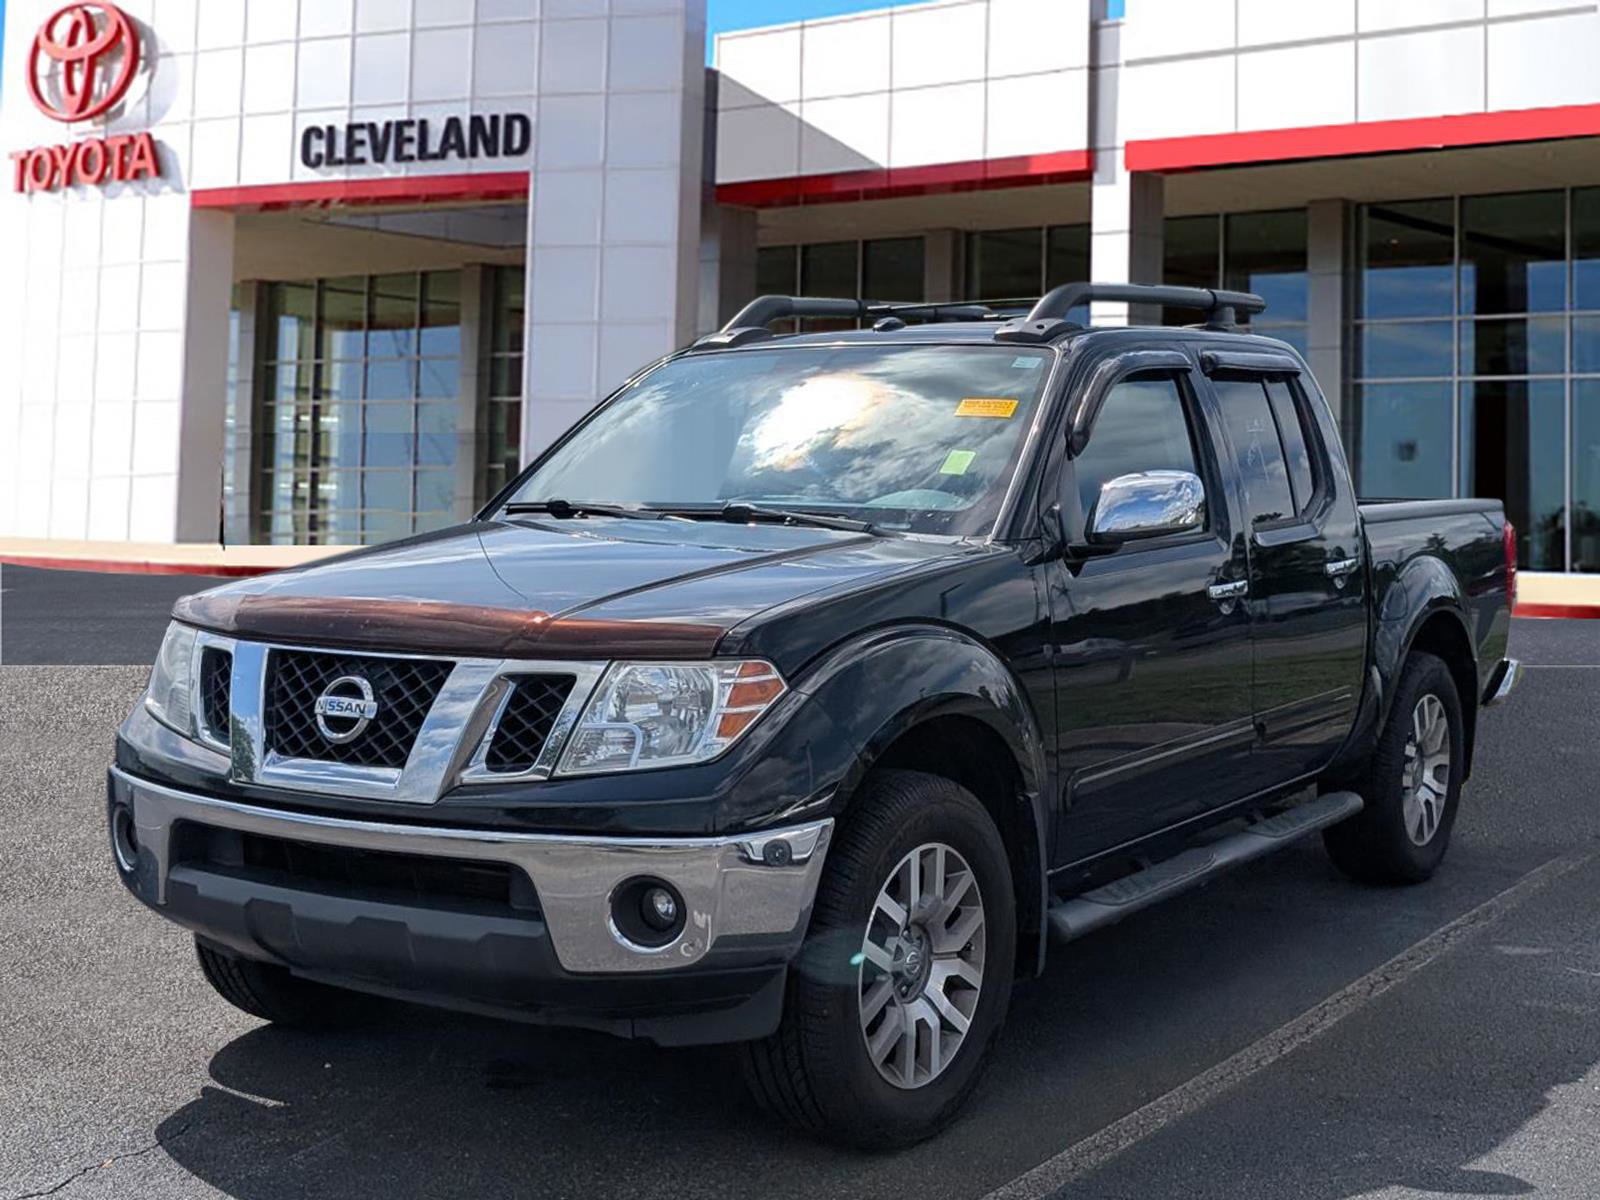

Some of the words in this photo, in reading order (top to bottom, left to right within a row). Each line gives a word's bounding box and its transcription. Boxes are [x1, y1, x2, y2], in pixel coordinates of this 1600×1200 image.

[9, 132, 160, 193] TOYOTA
[301, 113, 531, 169] CLEVELAND
[317, 700, 367, 714] NISSAN
